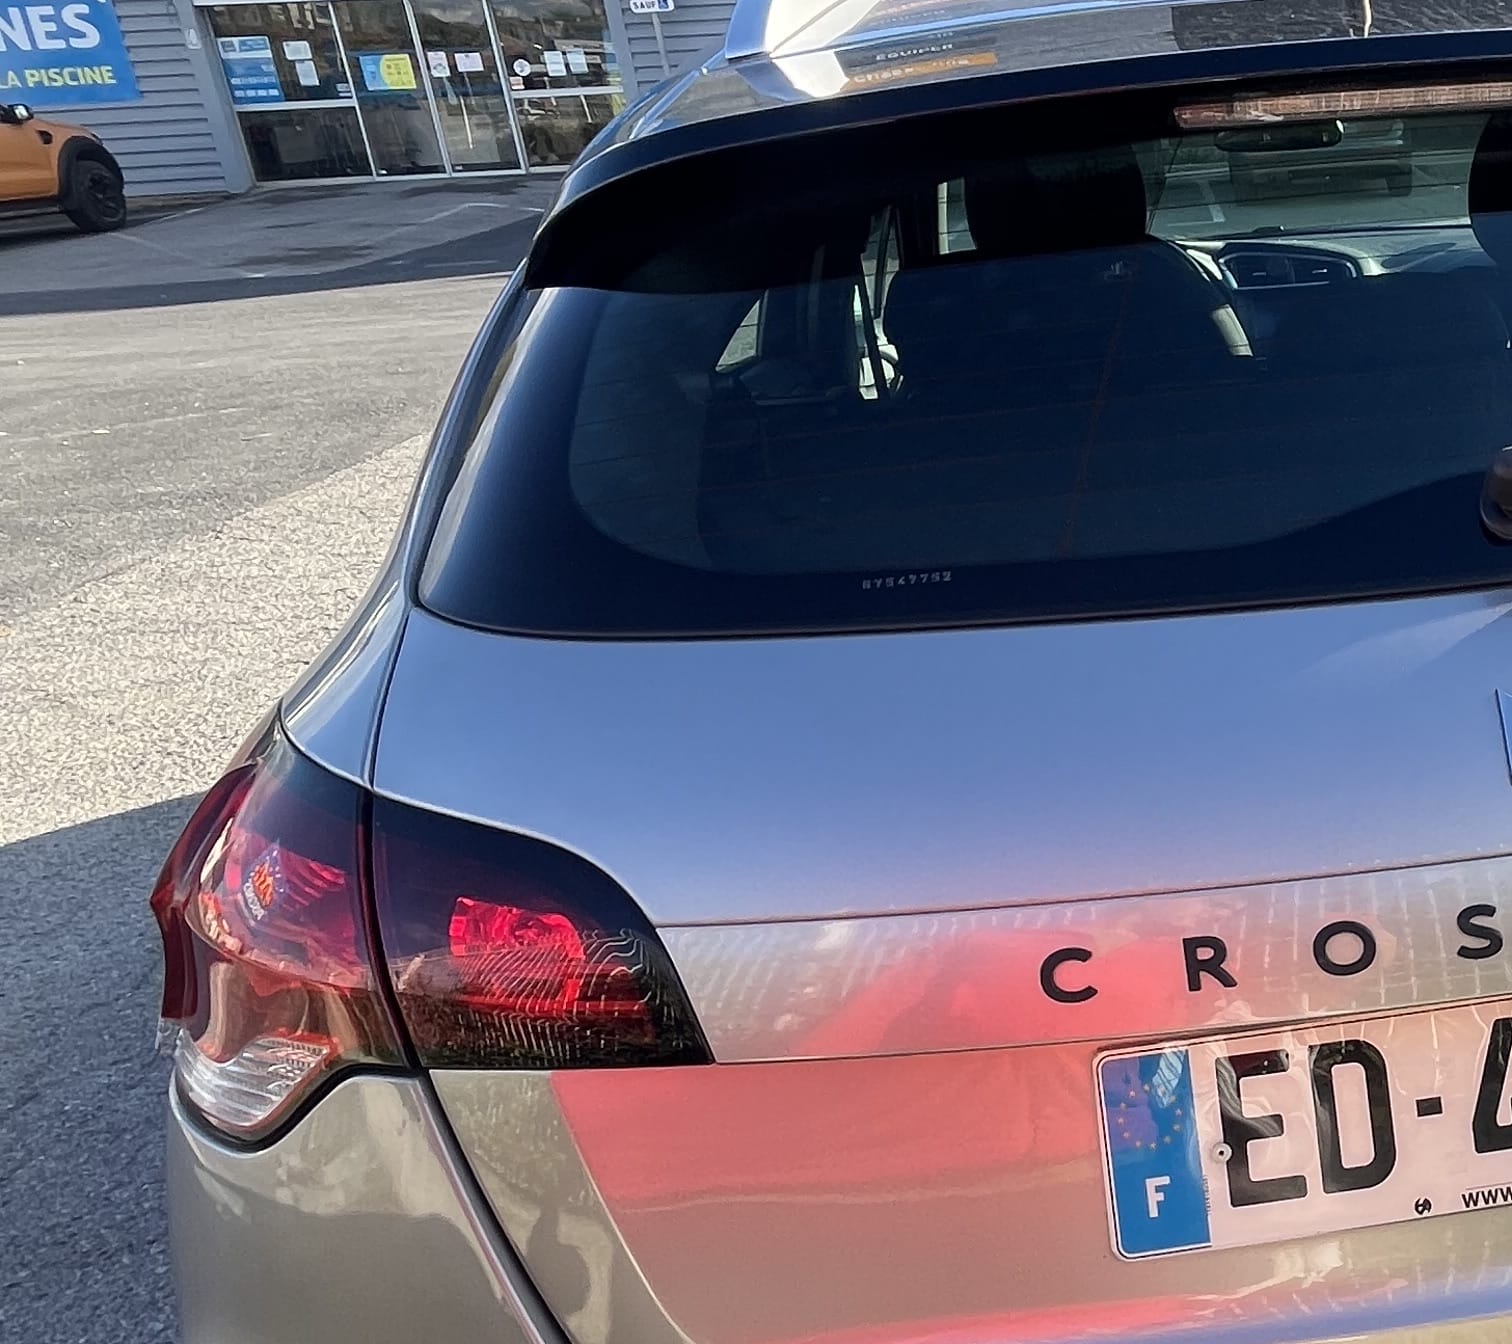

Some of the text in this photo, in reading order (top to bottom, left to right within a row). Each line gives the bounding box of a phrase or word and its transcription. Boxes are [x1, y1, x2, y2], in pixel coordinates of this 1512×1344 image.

[632, 0, 657, 10] SAUF
[24, 66, 117, 88] PISCINE
[1144, 1176, 1172, 1219] F
